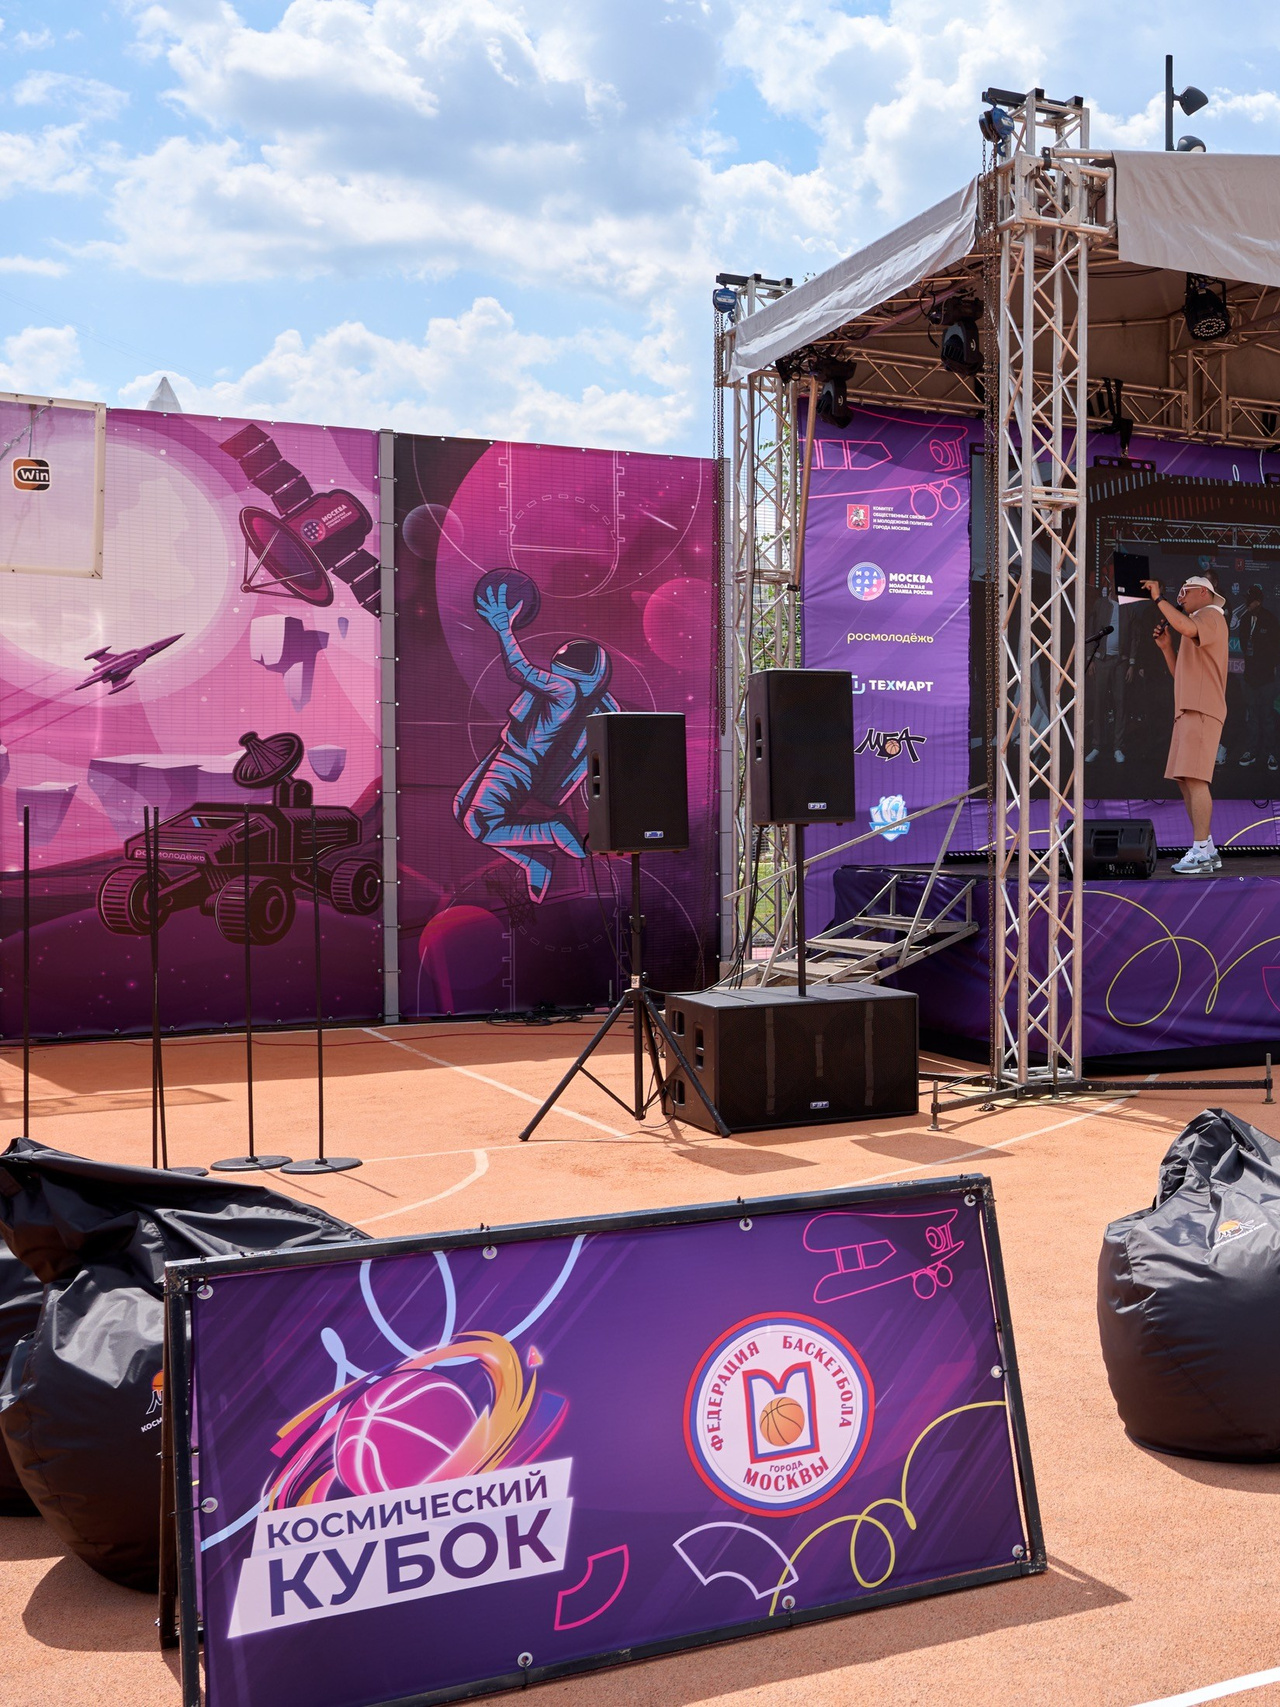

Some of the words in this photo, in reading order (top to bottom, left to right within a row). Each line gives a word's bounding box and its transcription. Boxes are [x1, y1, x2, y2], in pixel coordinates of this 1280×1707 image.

[20, 469, 49, 481] Win
[321, 504, 347, 522] МОСКВА
[889, 573, 933, 583] МОСКВА
[847, 633, 934, 644] росмолодёжь
[869, 680, 933, 692] ТЕХМАРТ
[707, 1341, 760, 1452] ФЕДЕРАЦИЯ
[782, 1335, 854, 1428] БАСКЕТБОЛА
[743, 1456, 829, 1492] МОСКВЫ
[769, 1460, 803, 1473] ГОРОДА
[267, 1469, 548, 1549] КОСМИЧЕСКИЙ
[268, 1508, 556, 1617] КУБОК
